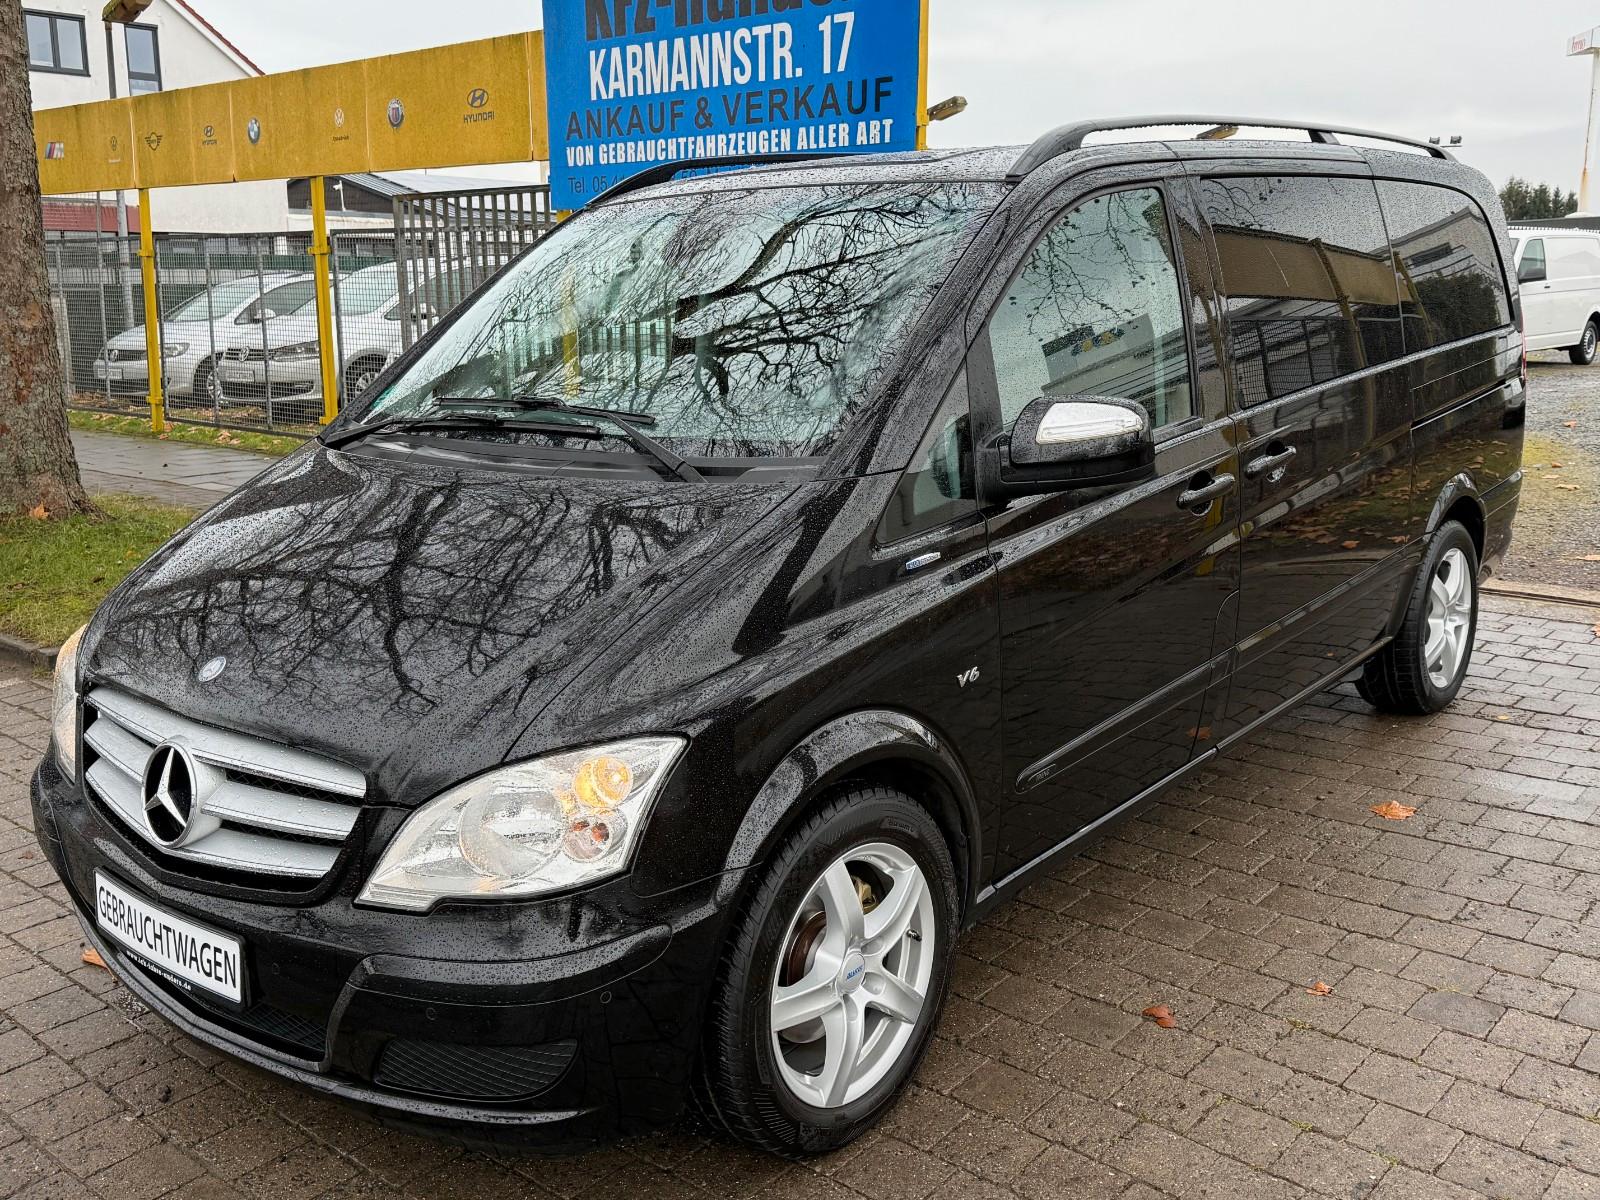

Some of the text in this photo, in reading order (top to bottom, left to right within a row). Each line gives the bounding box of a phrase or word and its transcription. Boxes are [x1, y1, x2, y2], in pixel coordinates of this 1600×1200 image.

[589, 22, 803, 100] KARMANNSTR.
[818, 11, 855, 74] 17
[463, 111, 495, 124] HYUNDAI
[566, 76, 893, 141] ANKAUF & VERKAUF
[566, 118, 893, 167] VON GEBRAUCHTFAHRZEUGEN ALLER ART
[567, 176, 588, 194] Tel.
[956, 666, 980, 688] V6
[99, 885, 237, 989] GEBRAUCHTWAGEN
